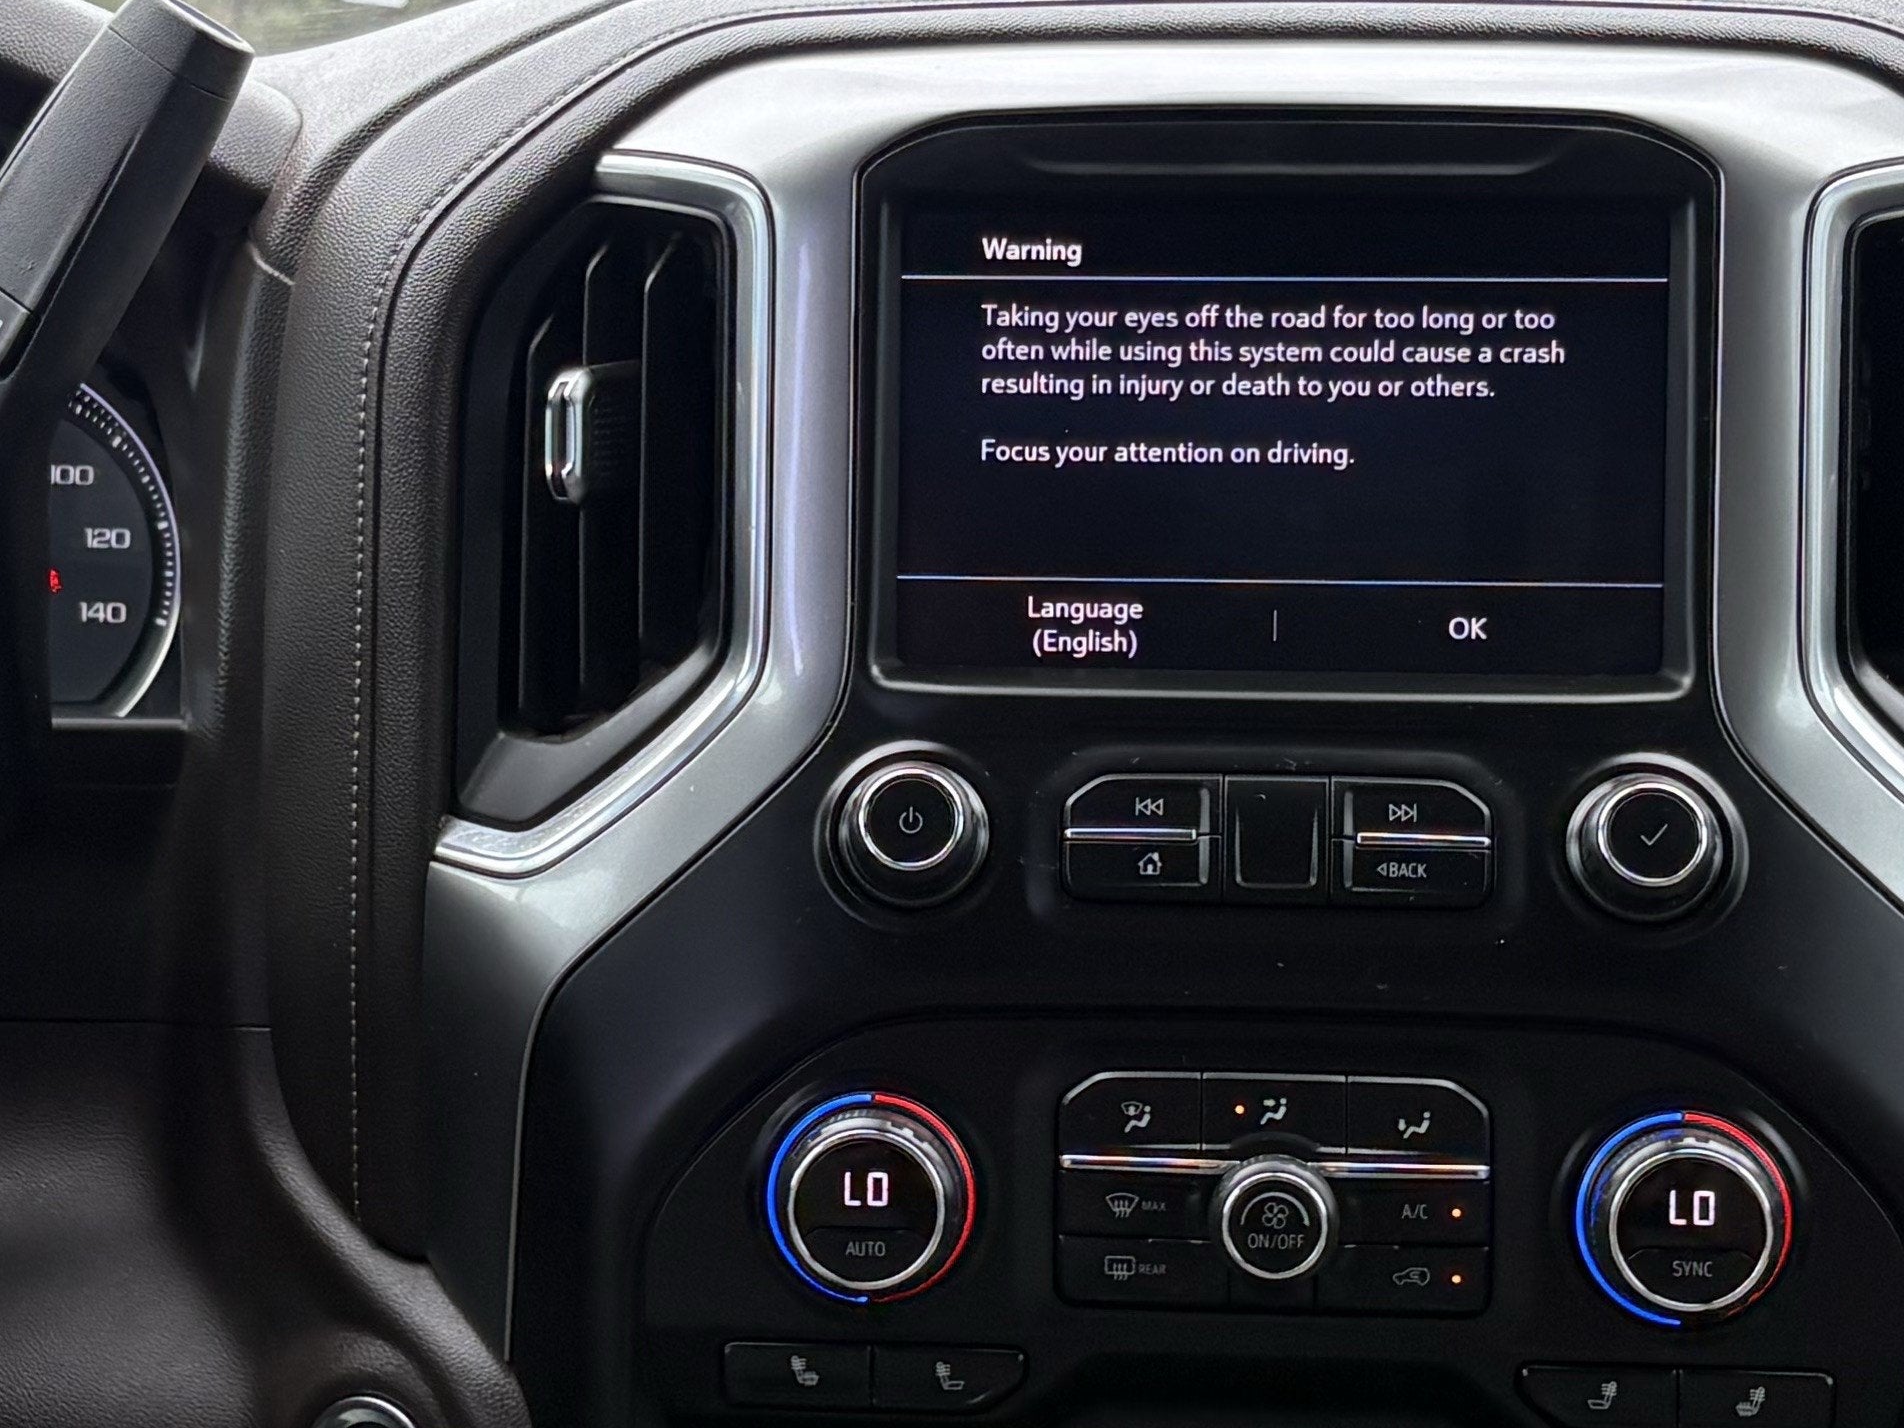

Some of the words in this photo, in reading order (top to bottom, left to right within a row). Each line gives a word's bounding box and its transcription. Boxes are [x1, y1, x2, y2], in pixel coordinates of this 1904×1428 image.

[981, 237, 1082, 267] Warning
[980, 302, 1060, 334] Taking
[1064, 311, 1118, 334] your
[1124, 311, 1179, 334] eyes
[1185, 303, 1220, 328] off
[1224, 304, 1264, 328] the
[1271, 304, 1326, 328] road
[1332, 304, 1368, 329] for
[1373, 308, 1415, 329] too
[1422, 304, 1474, 336] long
[1481, 313, 1507, 329] or
[1514, 309, 1555, 330] too
[981, 336, 1044, 361] often
[1050, 337, 1112, 361] while
[1119, 340, 1182, 368] using
[1188, 338, 1233, 362] this
[1238, 342, 1323, 368] system
[1329, 339, 1395, 363] could
[1402, 346, 1472, 363] cause
[1477, 346, 1492, 363] a
[1499, 339, 1565, 364] crash
[981, 370, 1084, 401] resulting
[1092, 373, 1112, 395] in
[1119, 374, 1184, 402] injury
[1189, 379, 1216, 396] or
[1222, 372, 1291, 396] death
[1297, 376, 1323, 396] to
[1327, 380, 1371, 403] you
[1378, 380, 1404, 397] or
[1410, 373, 1495, 397] others.
[981, 438, 1051, 462] Focus
[1054, 446, 1108, 468] your
[1114, 441, 1223, 463] attention
[1230, 447, 1260, 463] on
[1267, 440, 1355, 471] driving.
[84, 527, 132, 550] 120
[79, 601, 127, 624] 140
[1028, 595, 1144, 625] Language
[1448, 616, 1487, 640] OK
[1032, 628, 1137, 659] (English)
[1389, 861, 1427, 879] BACK
[1142, 1201, 1166, 1212] MAX
[1401, 1204, 1428, 1220] A/C
[845, 1240, 886, 1257] AUTO
[1248, 1233, 1305, 1250] ON/OFF
[1138, 1264, 1167, 1275] REAR
[1672, 1260, 1713, 1278] SYNC
